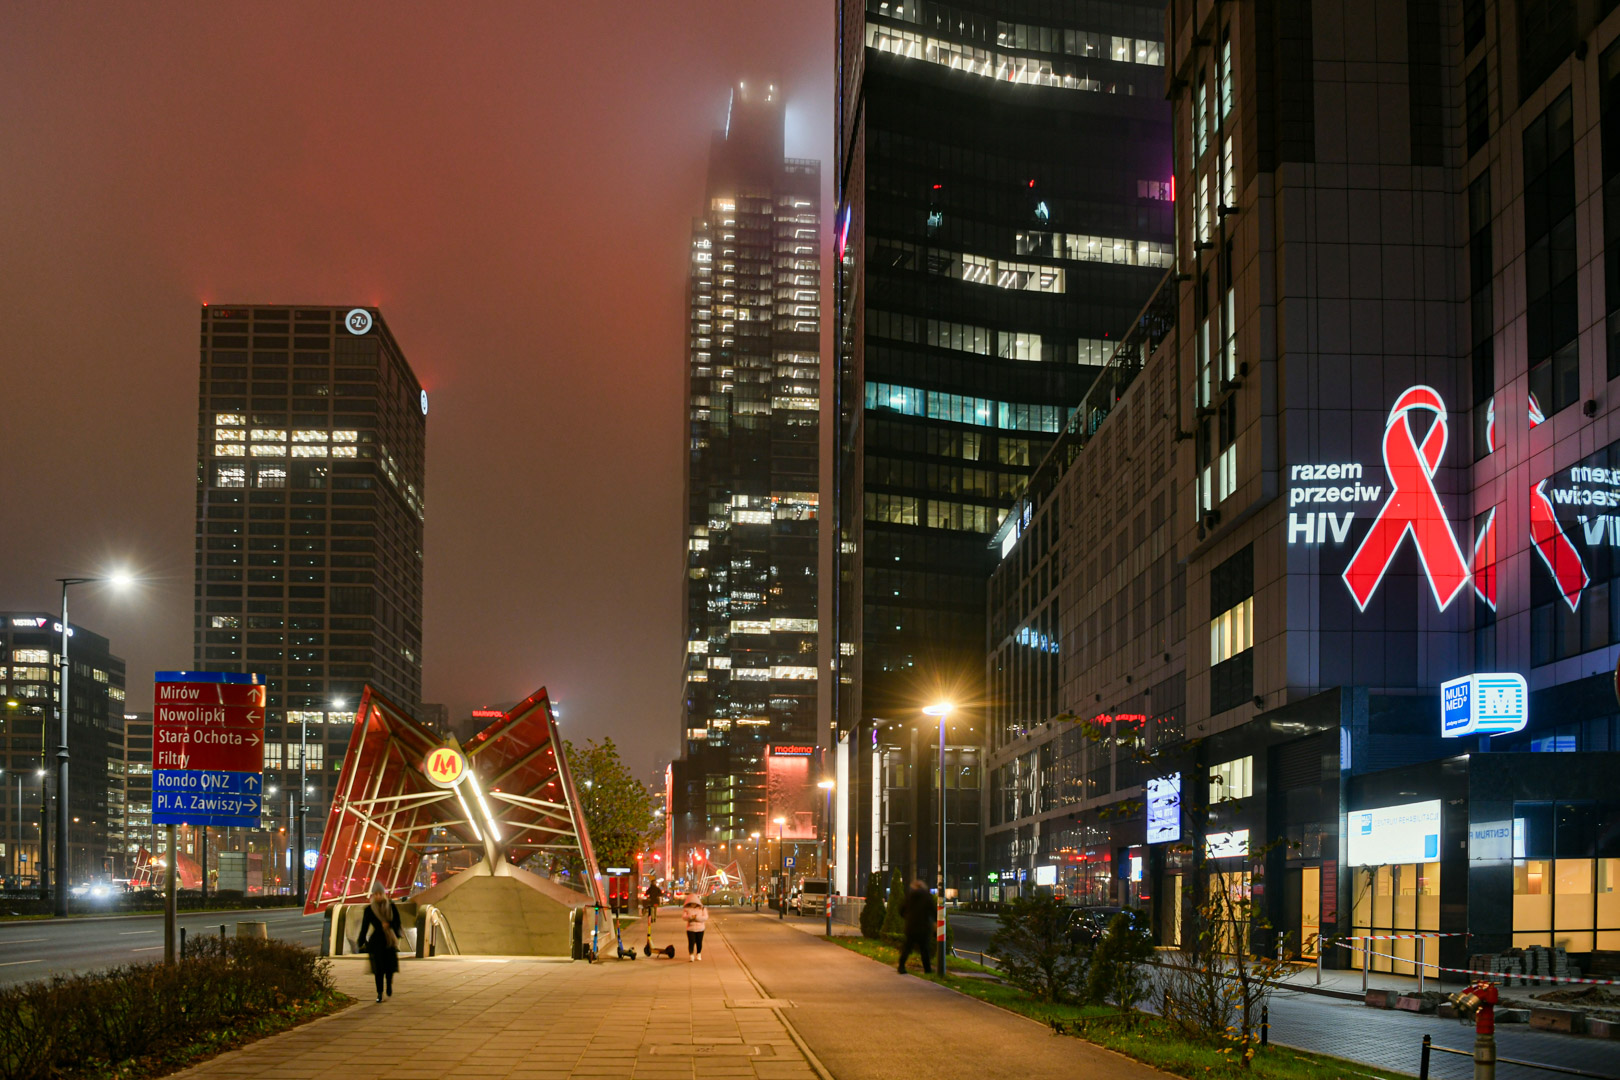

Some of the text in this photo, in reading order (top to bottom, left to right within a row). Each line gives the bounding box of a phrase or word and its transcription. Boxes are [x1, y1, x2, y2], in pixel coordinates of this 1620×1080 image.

[351, 316, 367, 328] PZU
[1291, 463, 1362, 480] razem
[1290, 482, 1381, 507] przeciw
[1288, 511, 1355, 543] HIV
[160, 685, 200, 700] Mirów
[1445, 684, 1469, 701] MULTI
[159, 707, 226, 725] Nowolipki
[158, 729, 242, 745] Stara Ochota
[775, 745, 813, 753] moderna
[158, 751, 190, 768] Filtry
[158, 773, 230, 788] Rondo ONZ
[157, 795, 243, 814] Pl. A. Zawiszy
[786, 857, 794, 867] P
